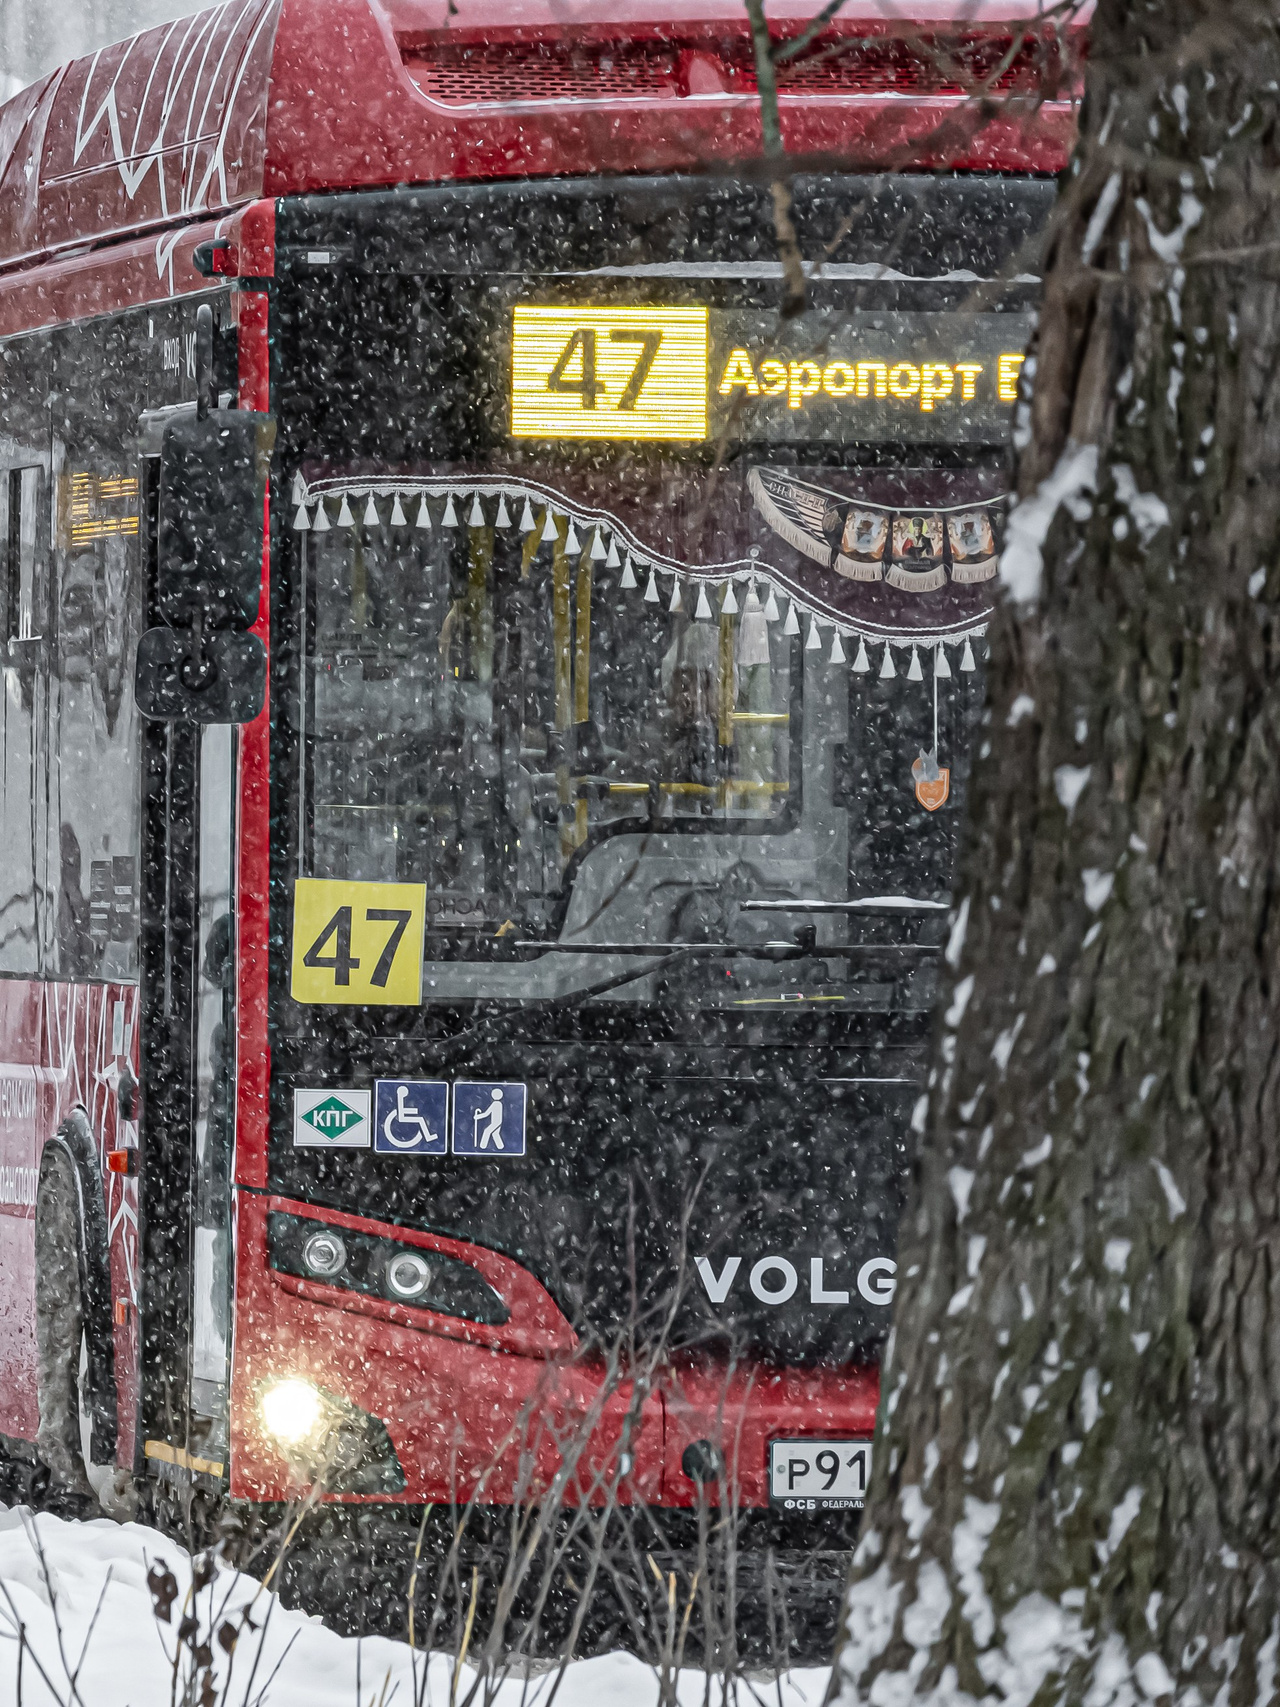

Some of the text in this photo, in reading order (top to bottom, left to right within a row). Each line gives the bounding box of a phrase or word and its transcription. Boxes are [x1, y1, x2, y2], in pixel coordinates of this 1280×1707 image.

[547, 329, 662, 411] 47
[719, 347, 984, 412] Аэропорт
[302, 906, 412, 988] 47
[313, 1109, 356, 1128] КПГ
[694, 1255, 898, 1305] VOLG
[784, 1499, 865, 1510] ФСБ ФЕДЕРАЛЬ
